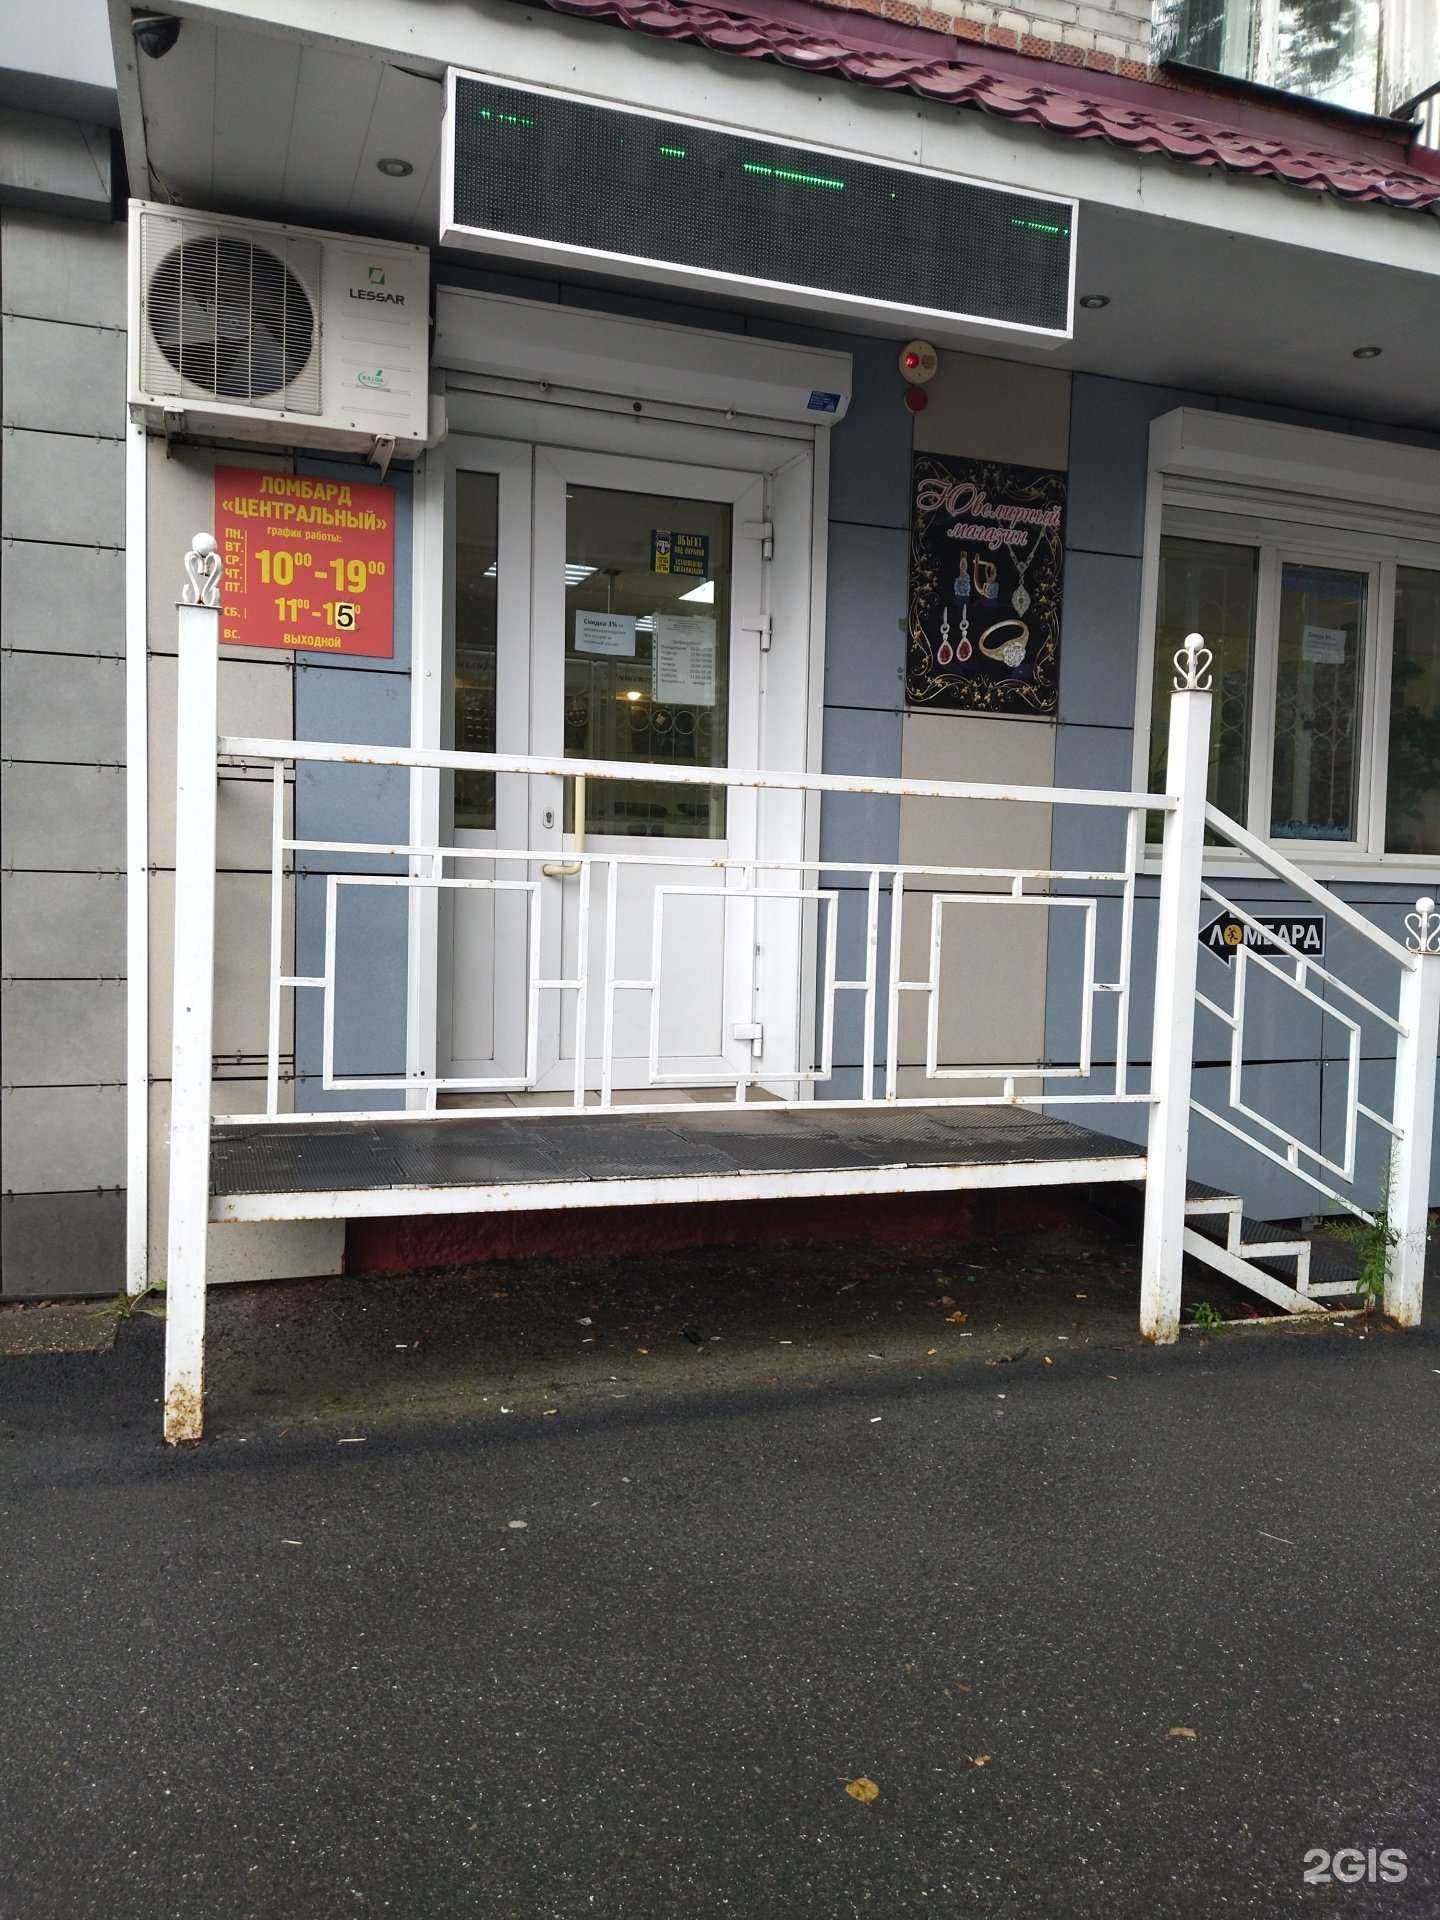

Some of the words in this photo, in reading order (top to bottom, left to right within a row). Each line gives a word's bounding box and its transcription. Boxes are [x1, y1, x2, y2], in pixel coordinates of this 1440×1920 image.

[349, 288, 405, 306] LESSAR
[260, 476, 352, 507] ЛОМБАРД
[916, 478, 1062, 527] Ювелирный
[222, 497, 387, 531] «ЦЕНТРАЛЬНЫЙ»
[267, 526, 301, 539] график
[947, 521, 1028, 550] магазин
[283, 632, 342, 648] ВЫХОДНОЙ
